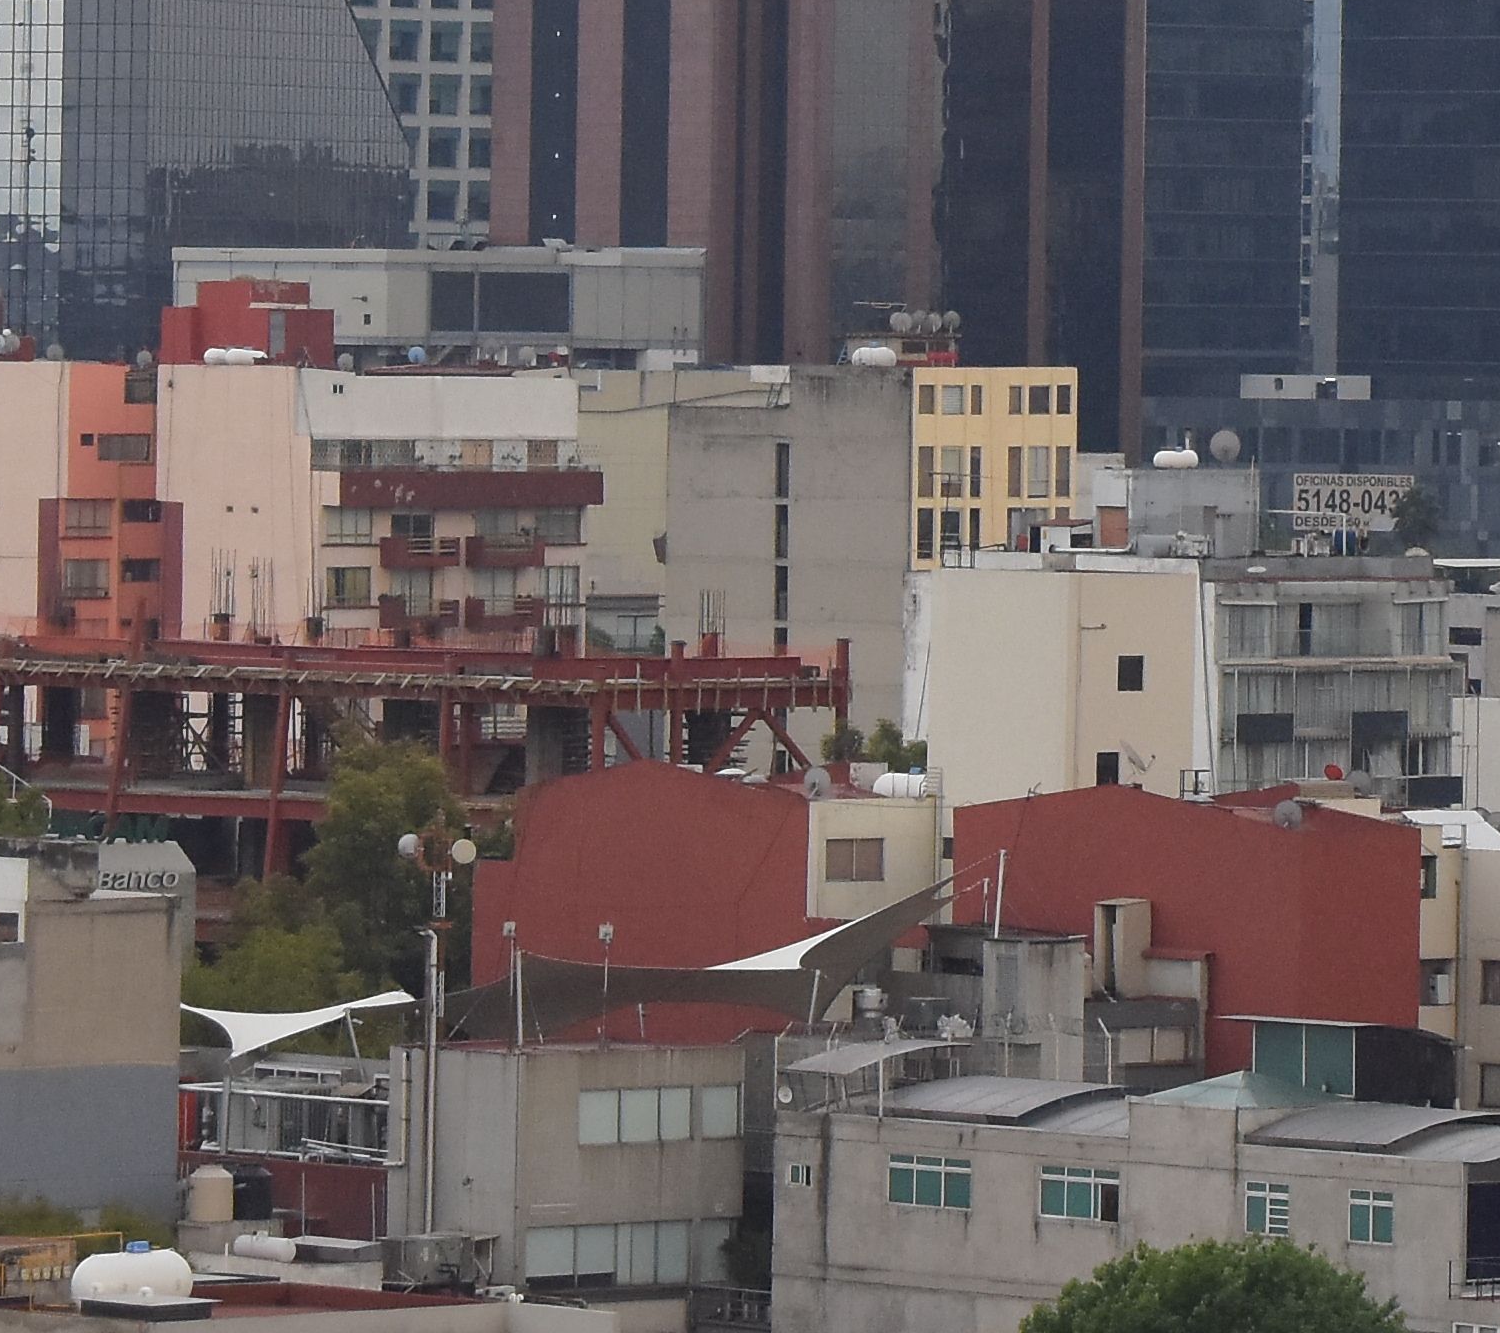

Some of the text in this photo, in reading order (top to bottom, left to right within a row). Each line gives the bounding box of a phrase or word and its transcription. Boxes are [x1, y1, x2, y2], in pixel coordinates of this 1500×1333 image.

[1296, 475, 1412, 488] OFICINAS DISPONIBLES
[1297, 488, 1403, 515] 5148-043
[1295, 516, 1336, 527] DESDE
[99, 870, 180, 890] Banco
